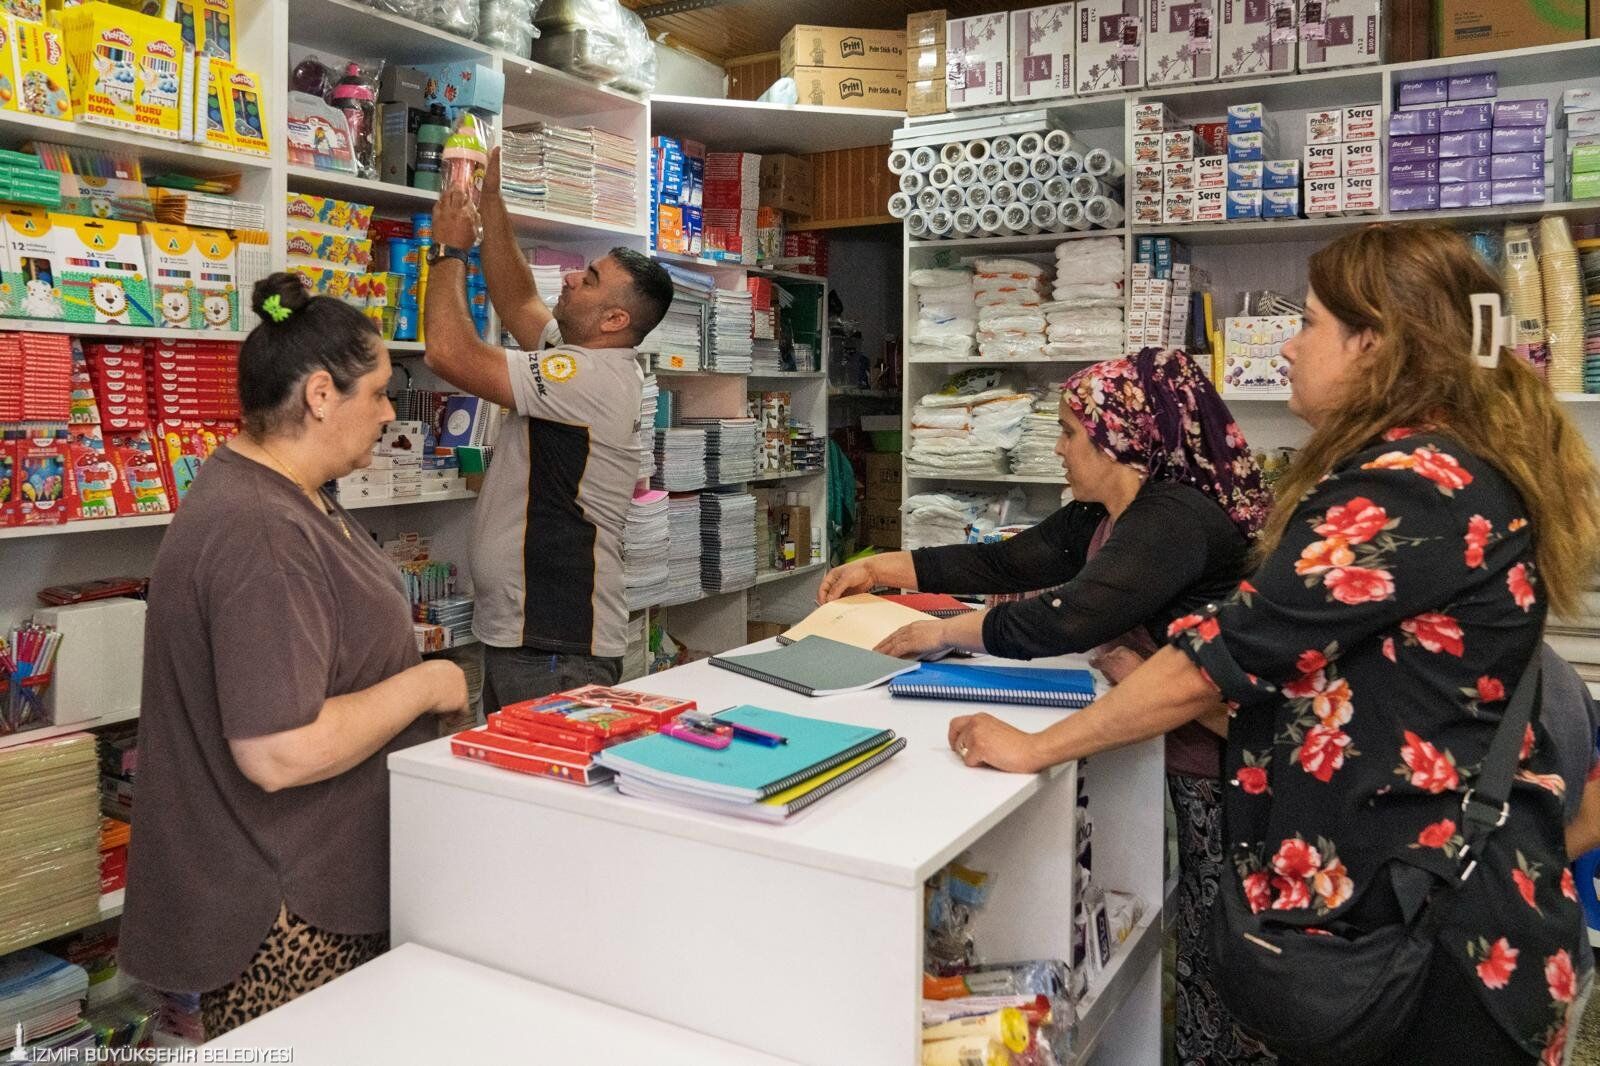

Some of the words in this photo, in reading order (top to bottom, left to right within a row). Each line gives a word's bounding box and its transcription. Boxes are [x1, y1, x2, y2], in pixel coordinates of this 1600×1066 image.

[843, 41, 860, 51] Pritt
[842, 82, 859, 92] Pritt
[1486, 82, 1493, 90] L
[1436, 87, 1443, 95] L
[88, 104, 114, 116] BOYA
[136, 104, 161, 115] KURU
[1348, 109, 1373, 118] Sera
[136, 114, 160, 125] BOYA
[1480, 113, 1487, 122] L
[1536, 111, 1543, 119] L
[1428, 119, 1434, 127] L
[1534, 135, 1541, 143] L
[1479, 140, 1486, 148] L
[1309, 147, 1333, 157] Sera
[1347, 145, 1372, 154] Sera
[1428, 145, 1434, 154] L
[1200, 158, 1222, 168] Sera
[1533, 162, 1540, 170] L
[1428, 170, 1434, 178] L
[1479, 166, 1486, 175] L
[1311, 182, 1335, 191] Sera
[1347, 178, 1372, 187] Sera
[79, 187, 90, 195] 20
[1198, 191, 1220, 200] Sera
[1480, 191, 1487, 199] L
[1533, 187, 1540, 195] L
[1428, 193, 1434, 202] L
[12, 242, 25, 251] 12
